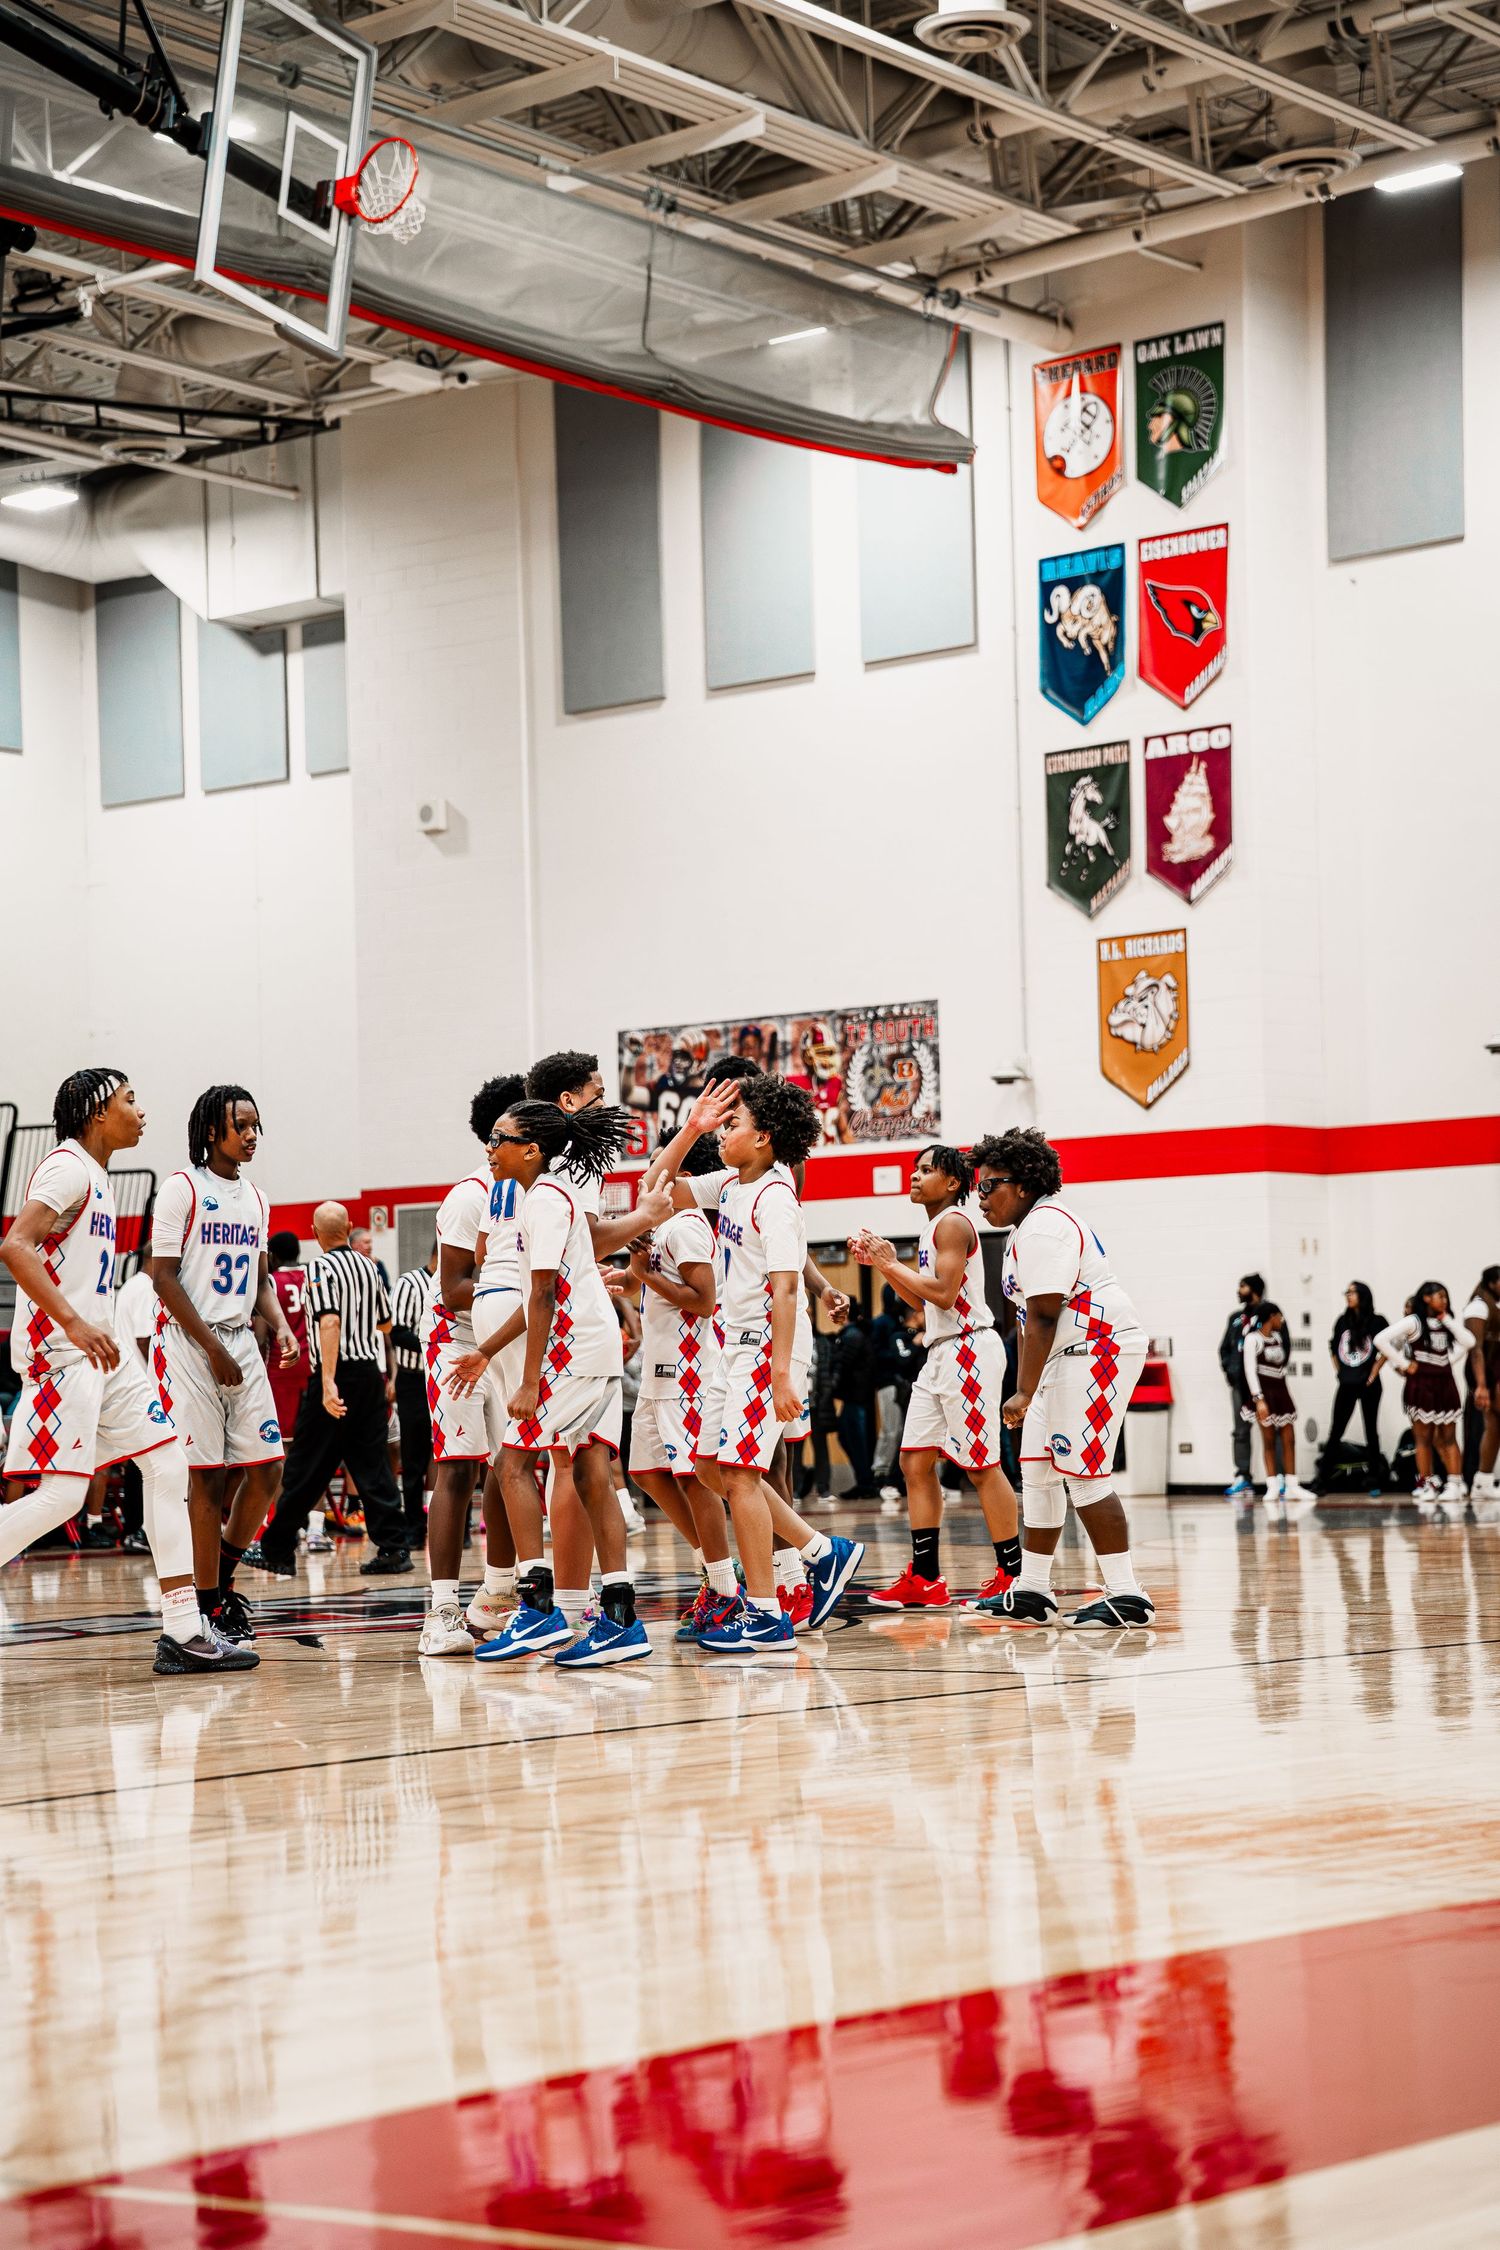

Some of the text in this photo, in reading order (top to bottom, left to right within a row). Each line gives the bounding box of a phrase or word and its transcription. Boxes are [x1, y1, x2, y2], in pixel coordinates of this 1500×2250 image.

[1137, 327, 1222, 364] OAK LAWN
[1140, 528, 1228, 562] EISENHOWER
[1145, 727, 1232, 760] ARGO
[1125, 932, 1185, 960] RICHARDS
[872, 1015, 935, 1043] SOUTH
[212, 1252, 251, 1296] 32
